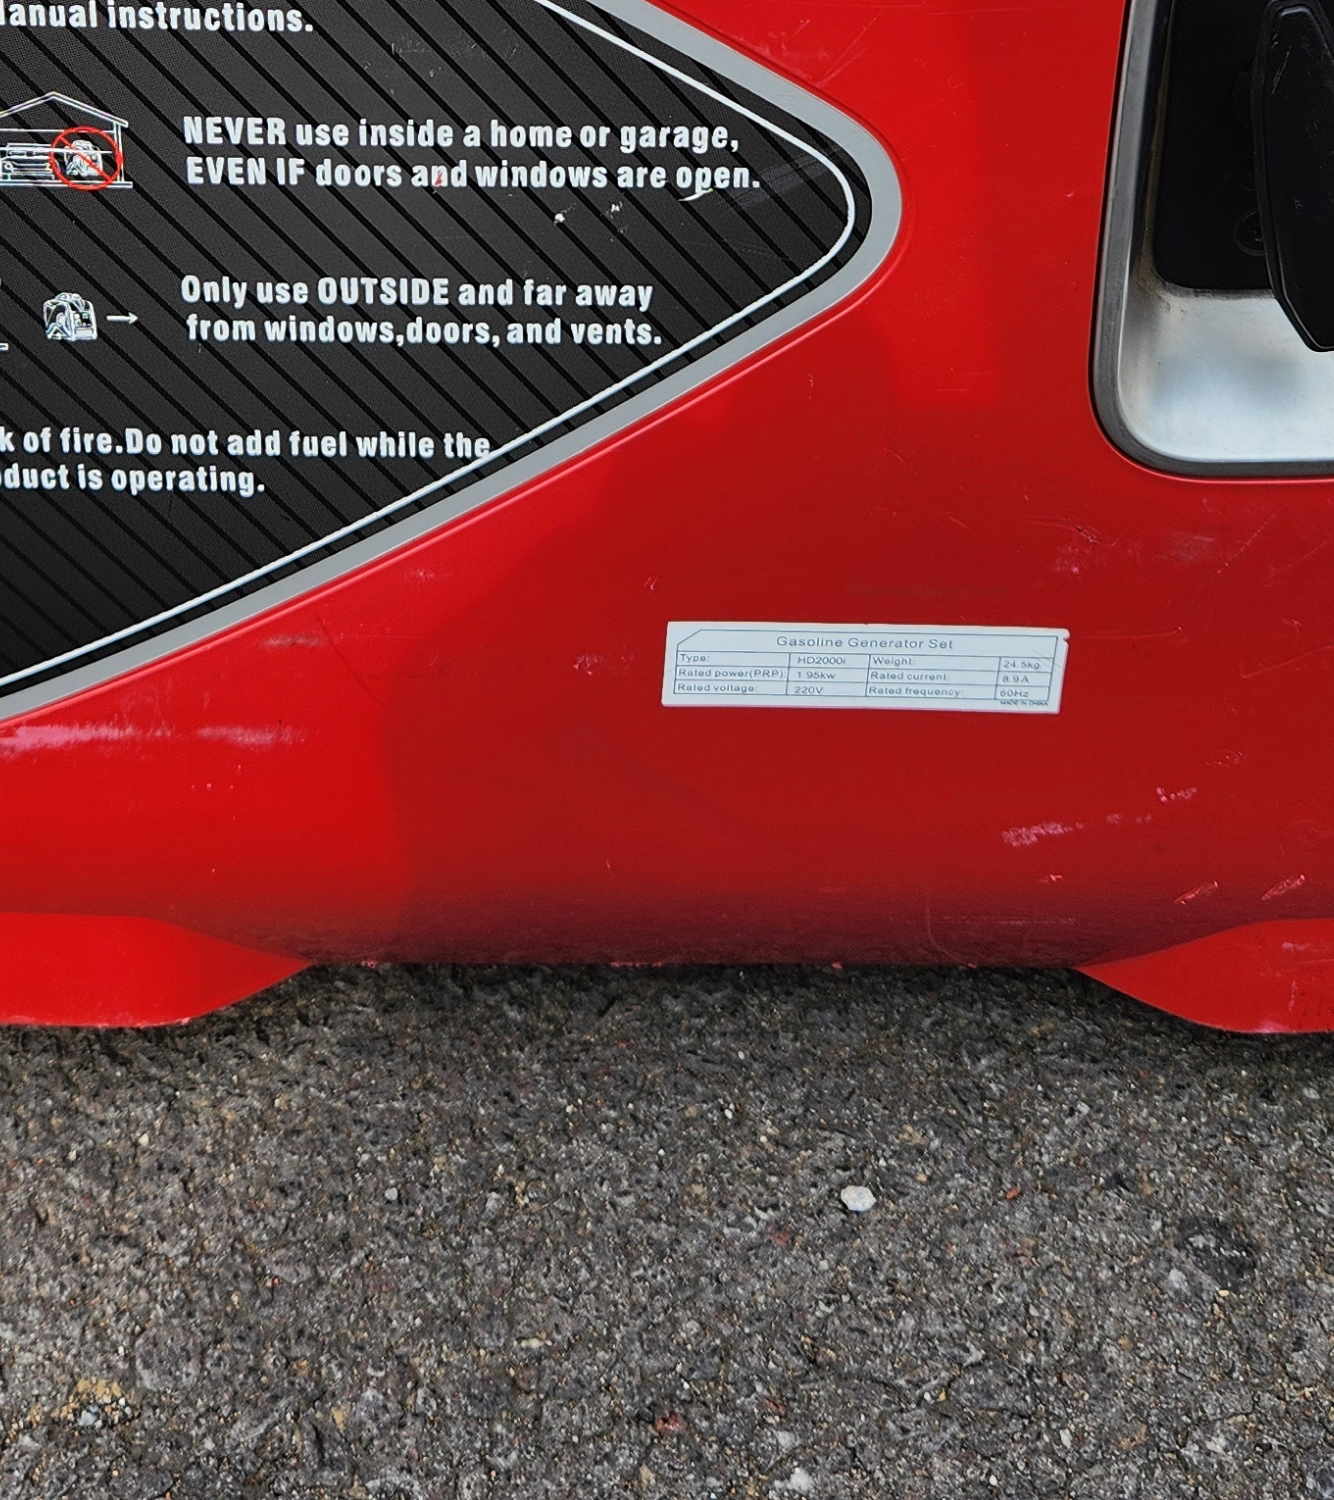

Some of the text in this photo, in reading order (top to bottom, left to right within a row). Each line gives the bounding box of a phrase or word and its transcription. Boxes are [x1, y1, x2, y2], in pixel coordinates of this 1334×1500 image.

[183, 115, 738, 154] NEVER use inside a home or garage,
[186, 156, 760, 189] EVEN IF doors and windows are open.
[181, 274, 653, 312] Only use OUTSIDE and far away
[186, 313, 256, 341] from
[506, 317, 561, 344] and
[570, 318, 661, 345] vents.
[23, 426, 51, 453] of
[170, 429, 219, 455] not
[227, 429, 280, 456] add
[288, 430, 347, 457] fuel
[355, 430, 434, 458] while
[443, 431, 491, 458] the
[77, 463, 103, 490] is
[111, 465, 265, 497] operating.
[776, 636, 954, 650] Gasoline Generator Set
[680, 653, 710, 663] Type:
[678, 669, 711, 677] Rated
[870, 671, 904, 680] Rated
[677, 683, 710, 692] Rated
[794, 686, 824, 694] 220V
[868, 686, 902, 695] Rated
